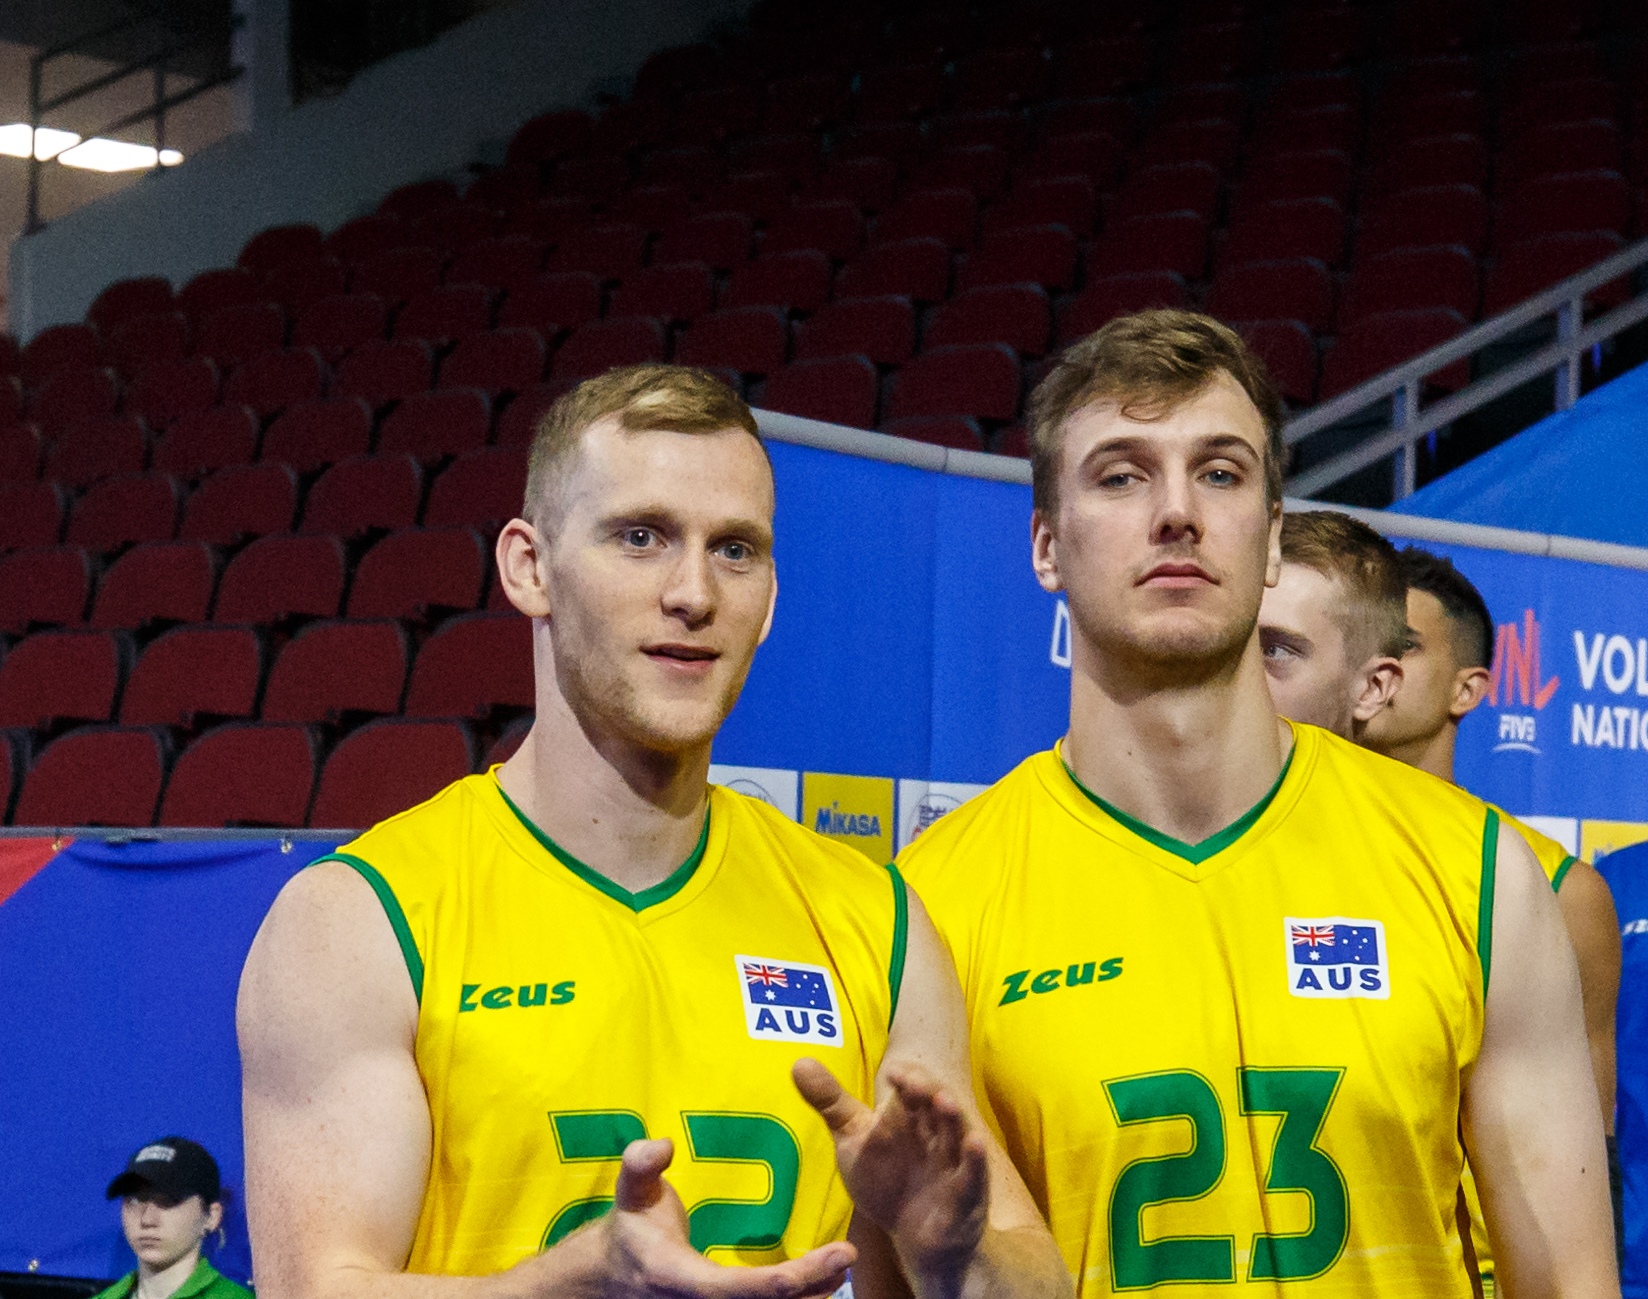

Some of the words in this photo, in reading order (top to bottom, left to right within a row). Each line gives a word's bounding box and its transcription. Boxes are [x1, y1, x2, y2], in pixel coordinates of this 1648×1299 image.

[999, 957, 1124, 1007] Zeus
[1296, 967, 1382, 992] AUS
[755, 1008, 838, 1039] AUS
[1100, 1066, 1351, 1293] 23
